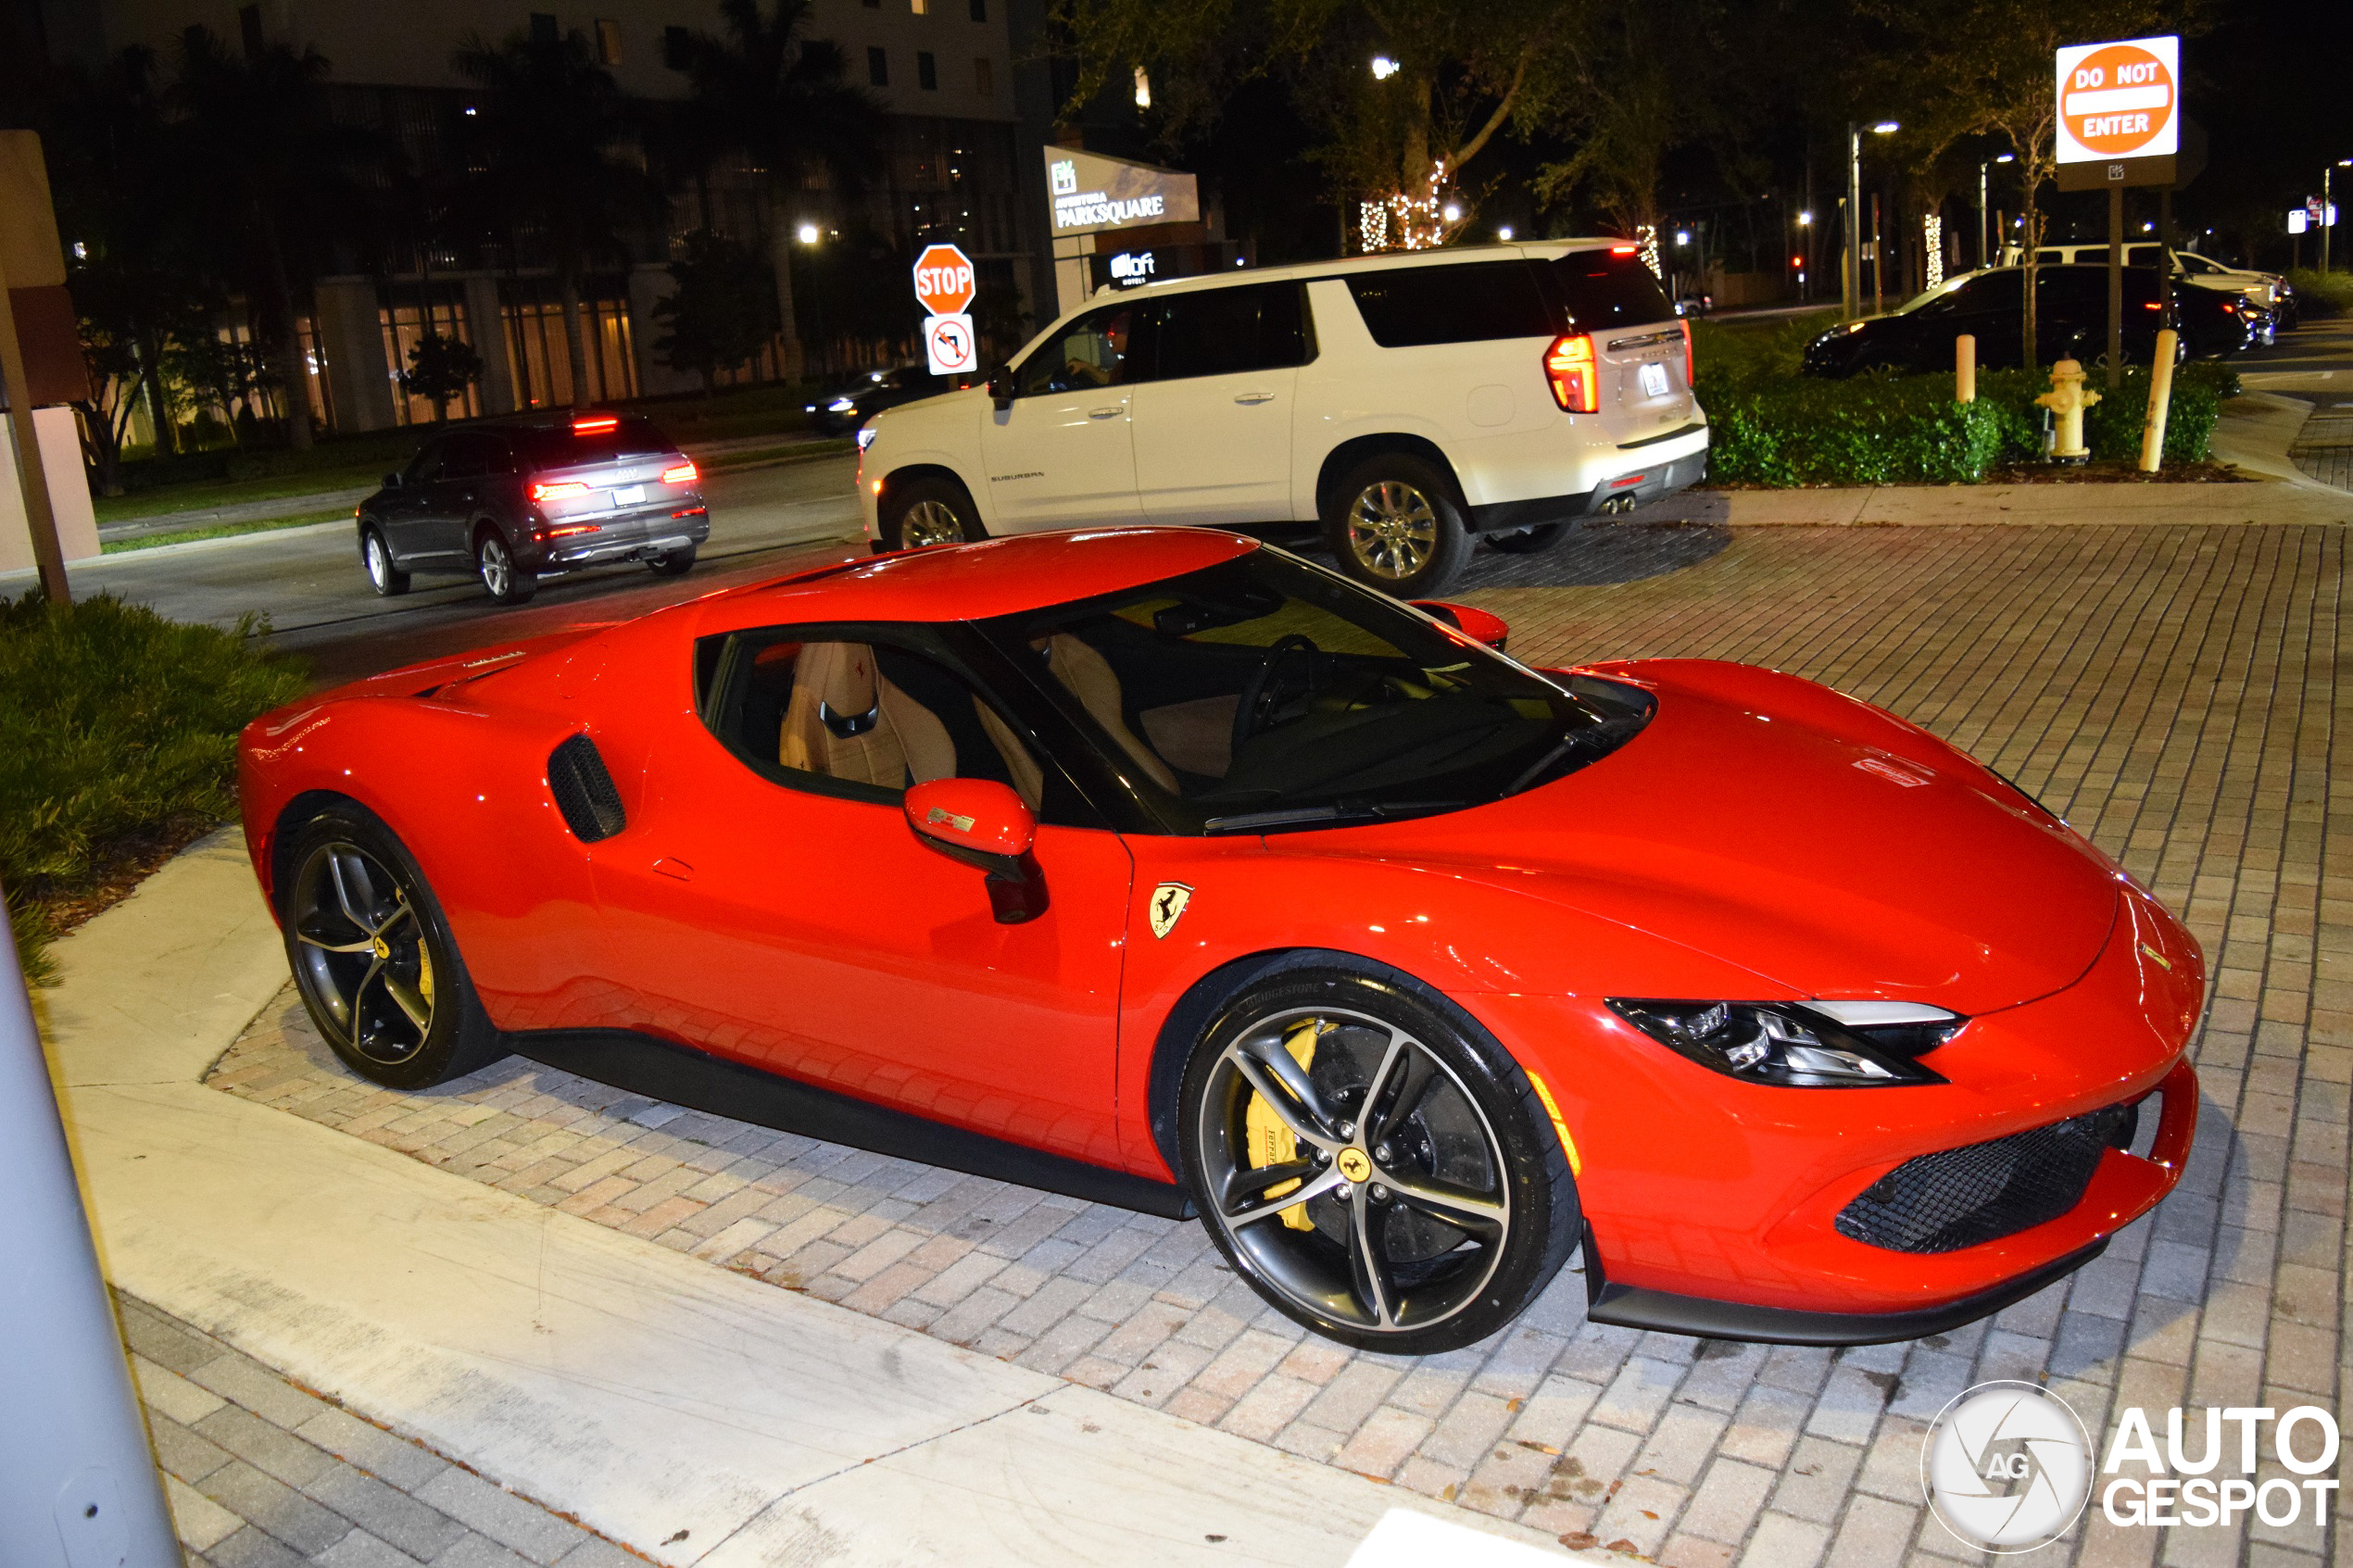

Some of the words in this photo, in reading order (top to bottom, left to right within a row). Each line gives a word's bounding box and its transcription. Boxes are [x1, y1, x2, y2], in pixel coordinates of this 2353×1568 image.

[2075, 68, 2104, 89] DO
[2117, 62, 2158, 85] NOT
[2083, 114, 2149, 138] ENTER
[1055, 195, 1164, 229] PARKSQUARE
[918, 266, 971, 296] STOP
[990, 471, 1045, 483] SUBURBAN
